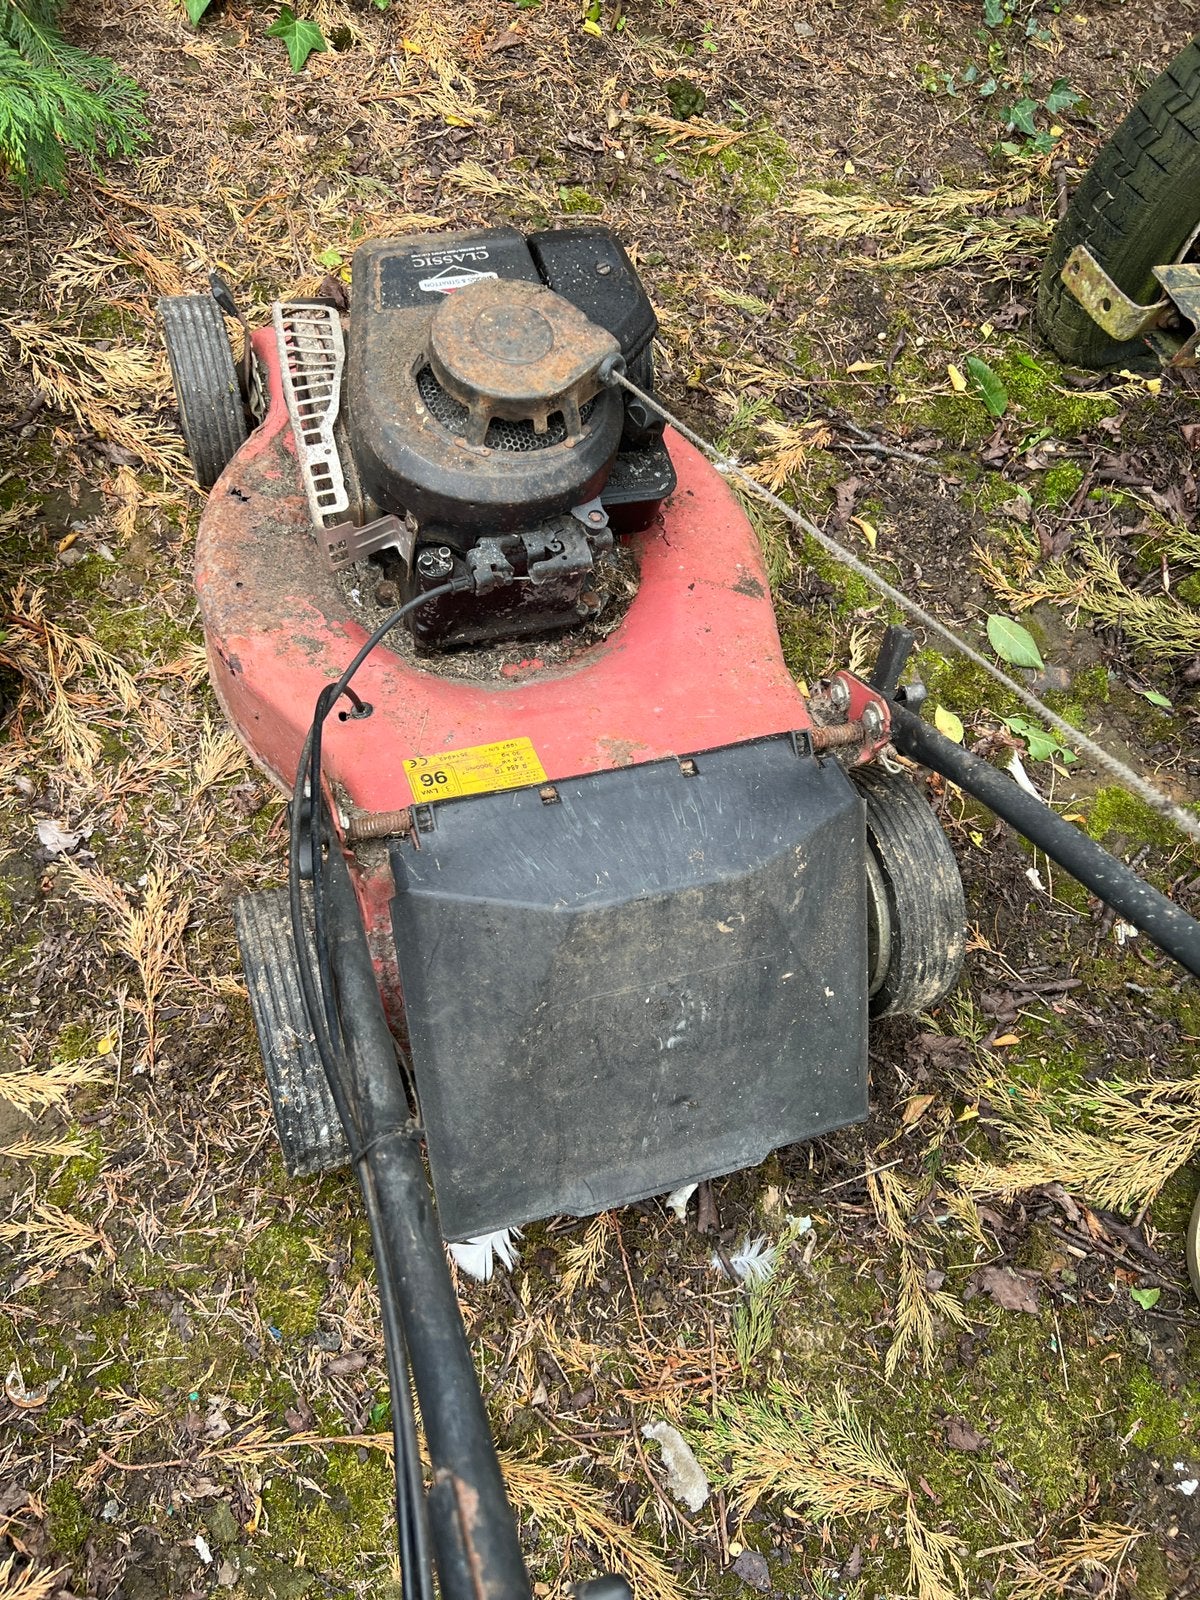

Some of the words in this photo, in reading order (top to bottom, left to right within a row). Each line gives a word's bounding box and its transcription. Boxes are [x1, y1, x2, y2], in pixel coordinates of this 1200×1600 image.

[412, 251, 489, 268] CLASSIC
[420, 771, 448, 787] 96
[421, 788, 439, 796] LWA
